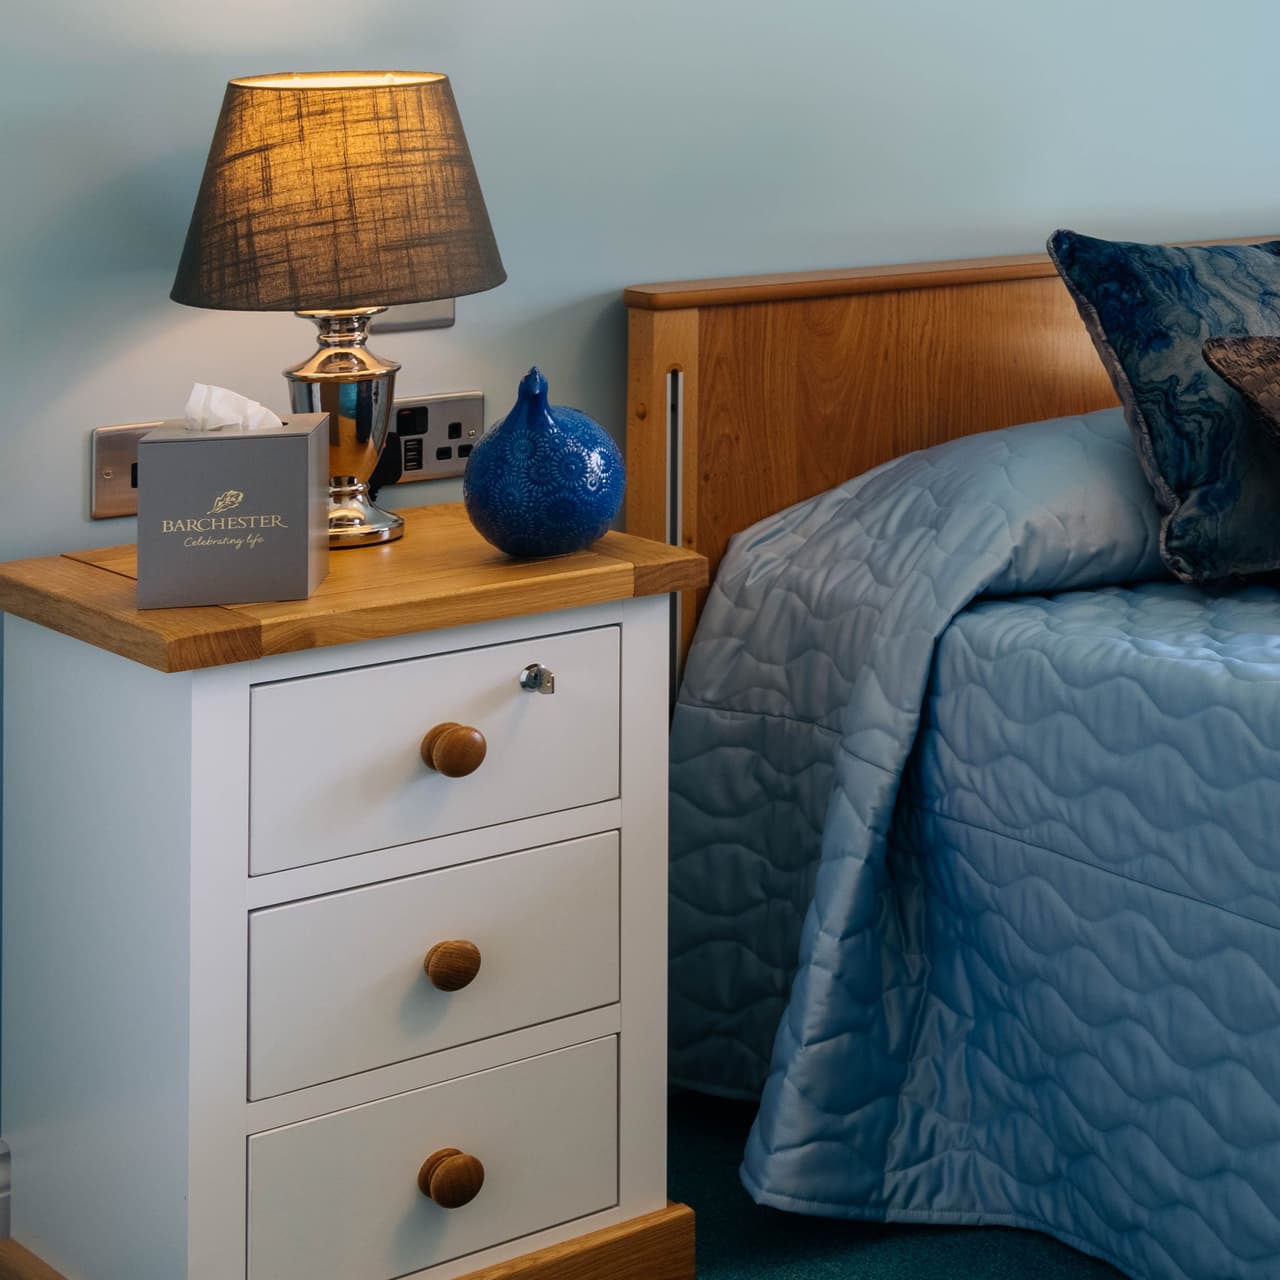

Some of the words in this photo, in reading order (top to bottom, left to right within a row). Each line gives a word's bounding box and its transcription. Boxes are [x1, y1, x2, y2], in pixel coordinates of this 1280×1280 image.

[161, 514, 289, 533] BARCHESTER
[184, 536, 244, 550] Celebrating
[246, 533, 265, 549] life
